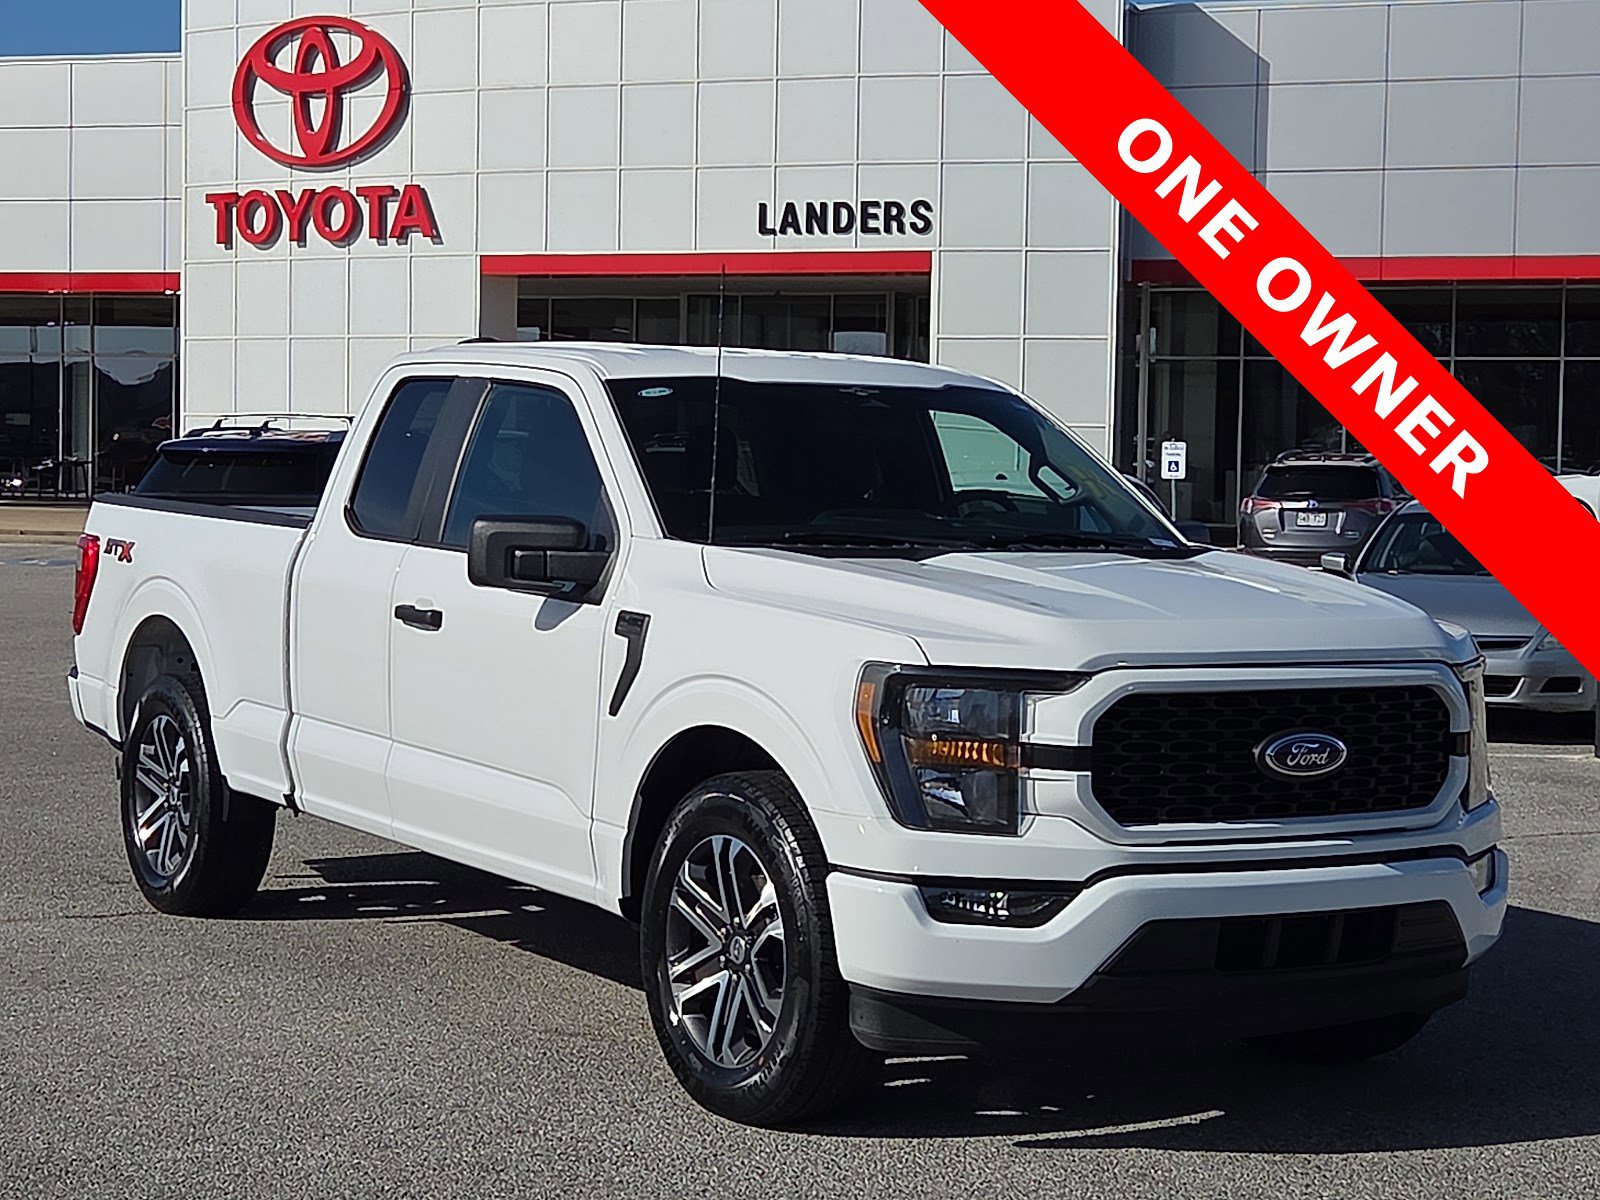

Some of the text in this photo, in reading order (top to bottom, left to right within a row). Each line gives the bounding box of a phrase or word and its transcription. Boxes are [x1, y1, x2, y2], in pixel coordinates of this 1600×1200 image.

[206, 185, 441, 248] TOYOTA
[758, 199, 933, 236] LANDERS
[1286, 742, 1331, 766] Ford
